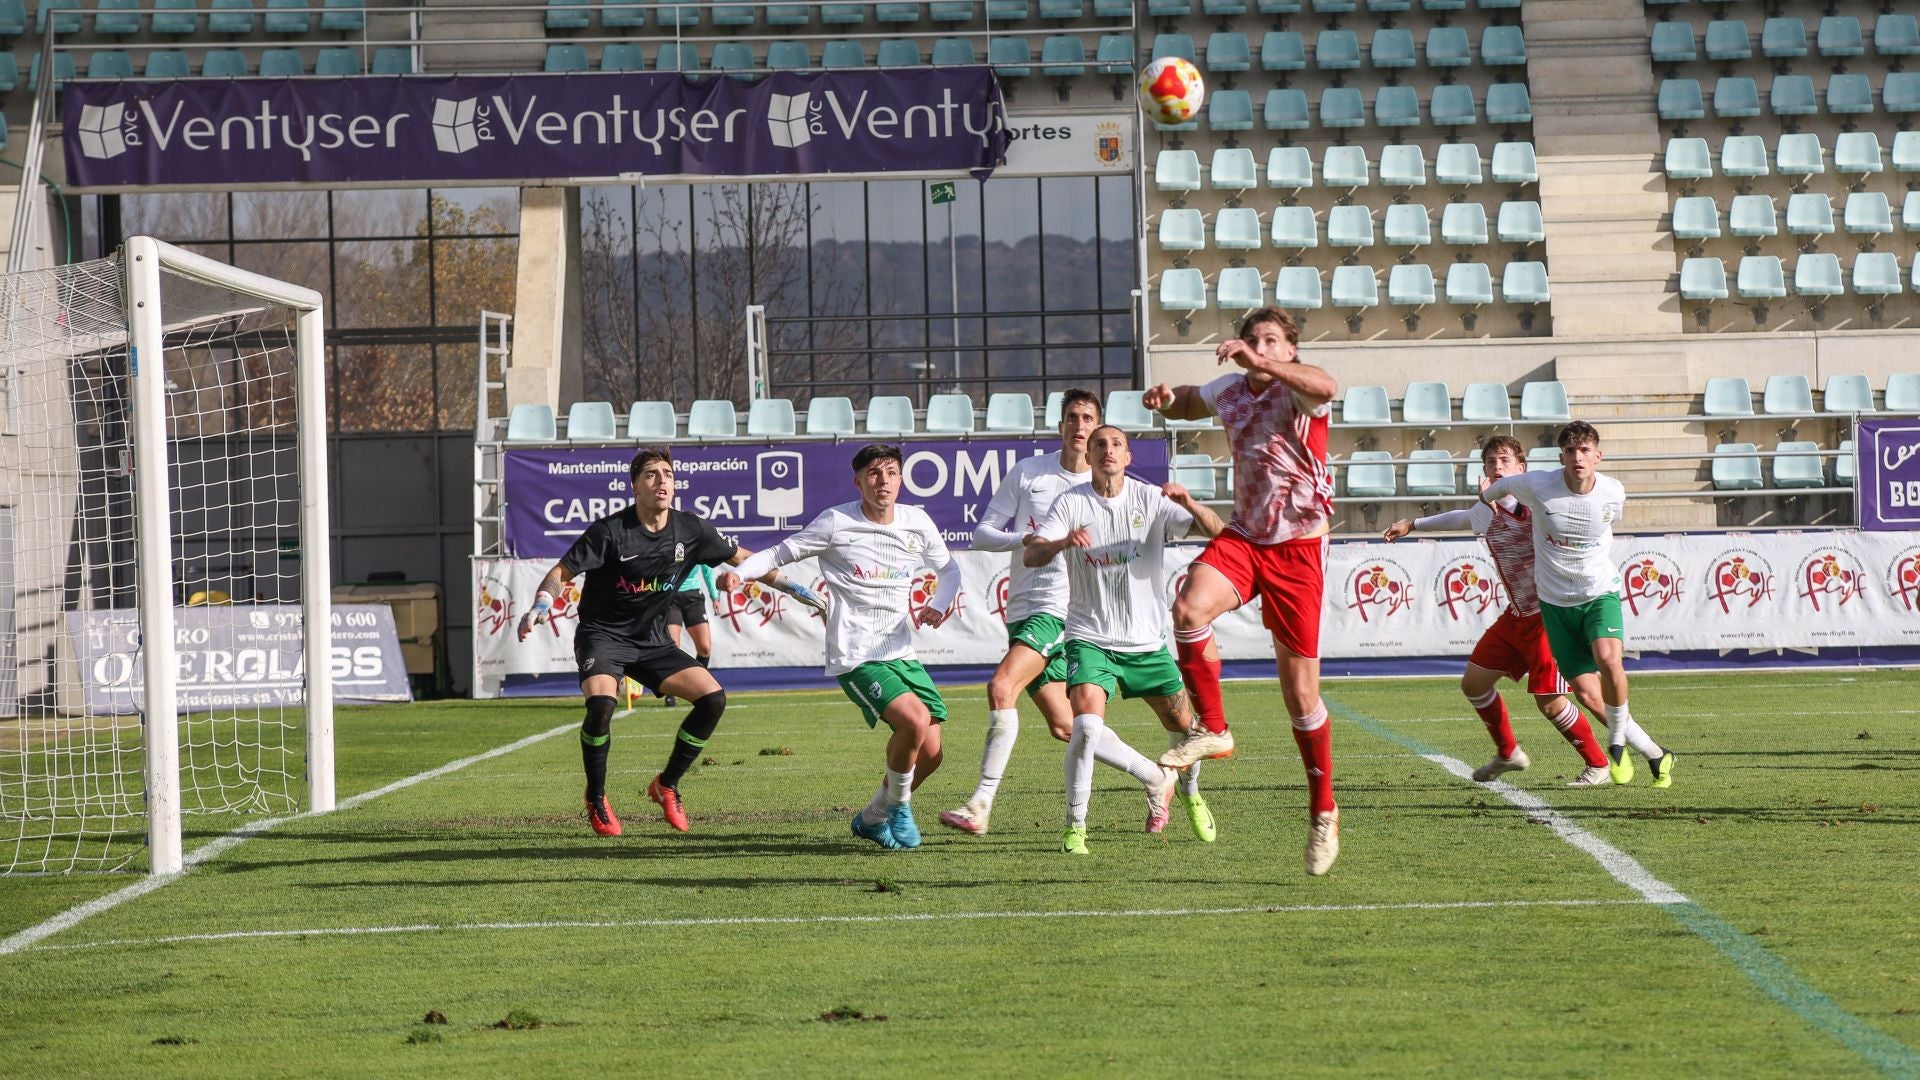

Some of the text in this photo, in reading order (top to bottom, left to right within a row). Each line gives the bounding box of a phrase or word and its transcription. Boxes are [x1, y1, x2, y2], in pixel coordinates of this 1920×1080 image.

[125, 99, 410, 161] pvc Ventyser
[477, 94, 748, 156] pvc Ventyser
[809, 100, 828, 136] pvc
[673, 458, 748, 474] Reparación
[608, 478, 626, 491] de
[694, 494, 751, 520] SAT
[345, 612, 377, 627] 600
